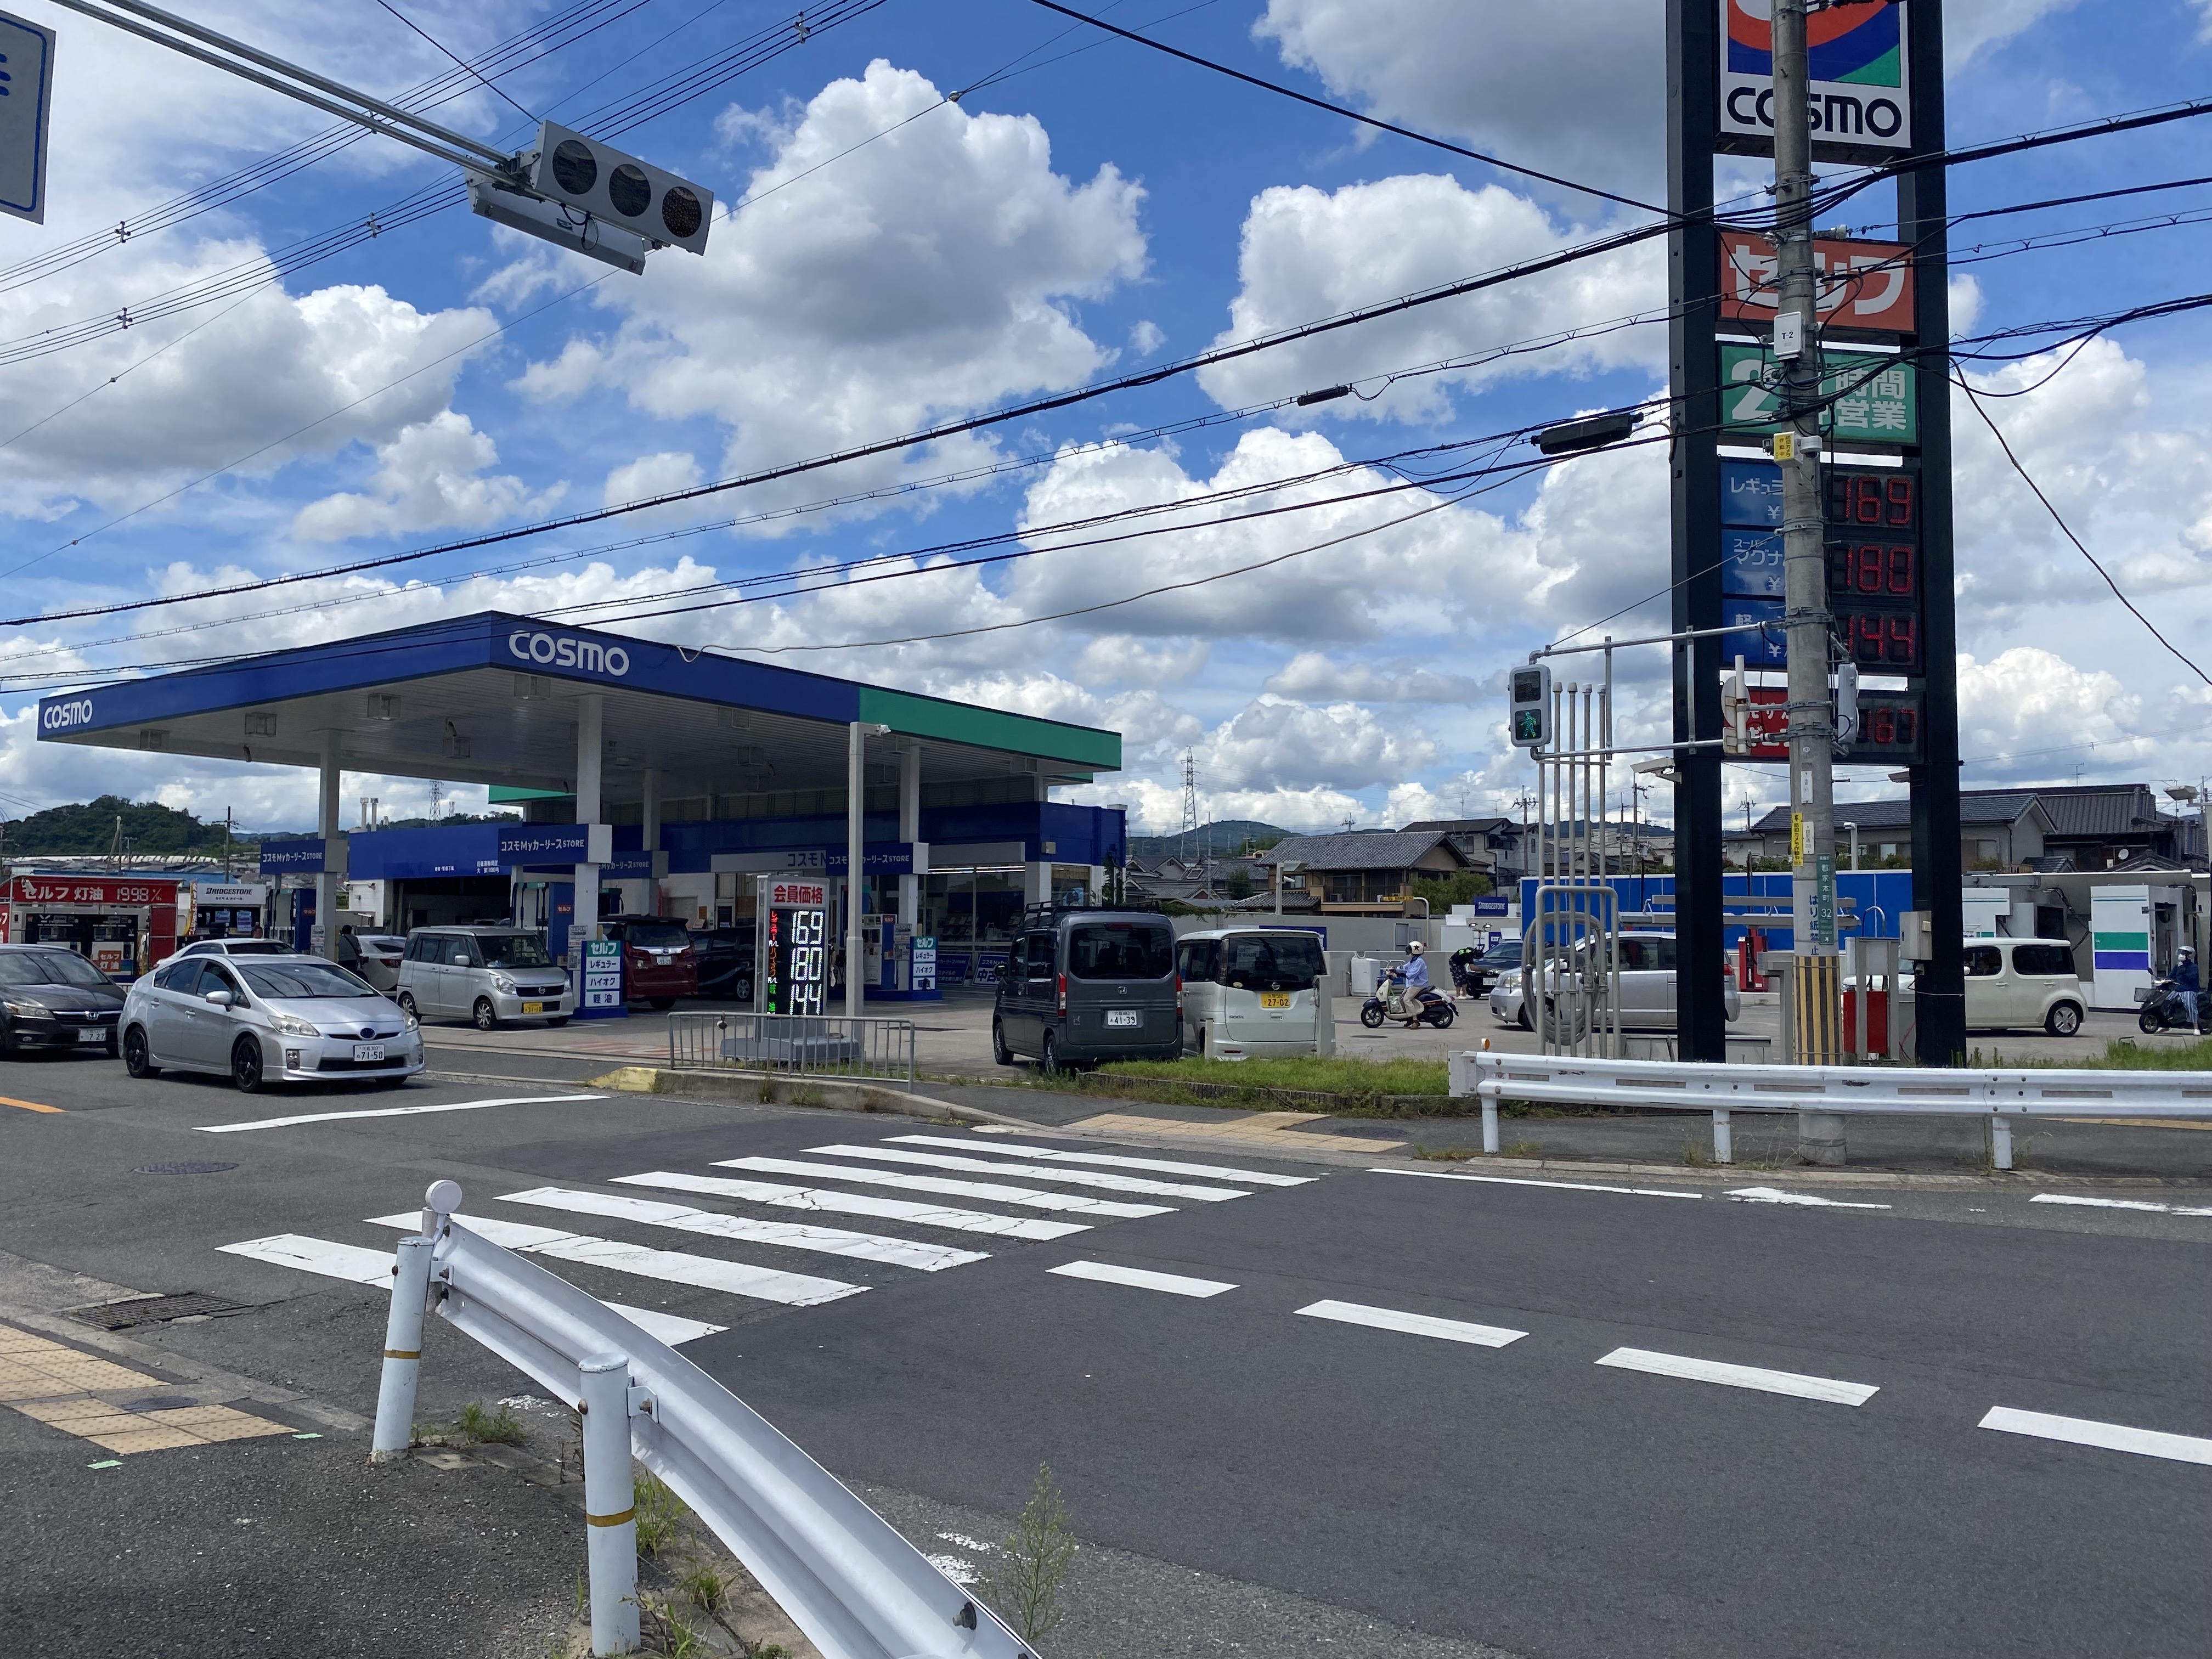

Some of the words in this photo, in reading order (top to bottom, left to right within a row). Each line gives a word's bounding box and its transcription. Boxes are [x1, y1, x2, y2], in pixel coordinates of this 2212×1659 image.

[1782, 331, 1793, 339] T-2
[1836, 368, 1906, 400] 時間
[1836, 400, 1907, 430] 営業
[1731, 477, 1783, 495] レギュラ
[1846, 476, 1912, 524] 169
[1768, 505, 1781, 520] ¥
[1734, 549, 1785, 566] マグナ
[1847, 544, 1913, 593] 180
[1768, 577, 1781, 590] ¥
[1847, 614, 1915, 658] 144
[509, 630, 630, 676] COSMO
[43, 699, 93, 729] COSMO
[501, 839, 584, 851] コスモMyカーリースSTORE
[22, 885, 69, 900] セルフ
[74, 887, 104, 901] 灯油
[117, 887, 149, 901] 1998
[206, 887, 253, 895] BRIDGESTONE
[774, 884, 823, 905] 会員価格
[1478, 901, 1505, 910] BRIDGESTONE
[1821, 908, 1832, 917] 32
[791, 911, 823, 945] 169
[591, 942, 617, 955] セルフ
[917, 938, 934, 948] セルフ
[100, 961, 120, 970] 灯油
[590, 960, 617, 969] レギュラー
[790, 947, 823, 981] 180
[590, 977, 616, 986] ハイオク
[977, 969, 1001, 982] 中古
[592, 994, 613, 1004] 軽油
[789, 983, 822, 1015] 144
[1267, 998, 1289, 1007] 27-02
[1114, 1016, 1136, 1024] 41-39
[361, 1051, 383, 1060] 71-50
